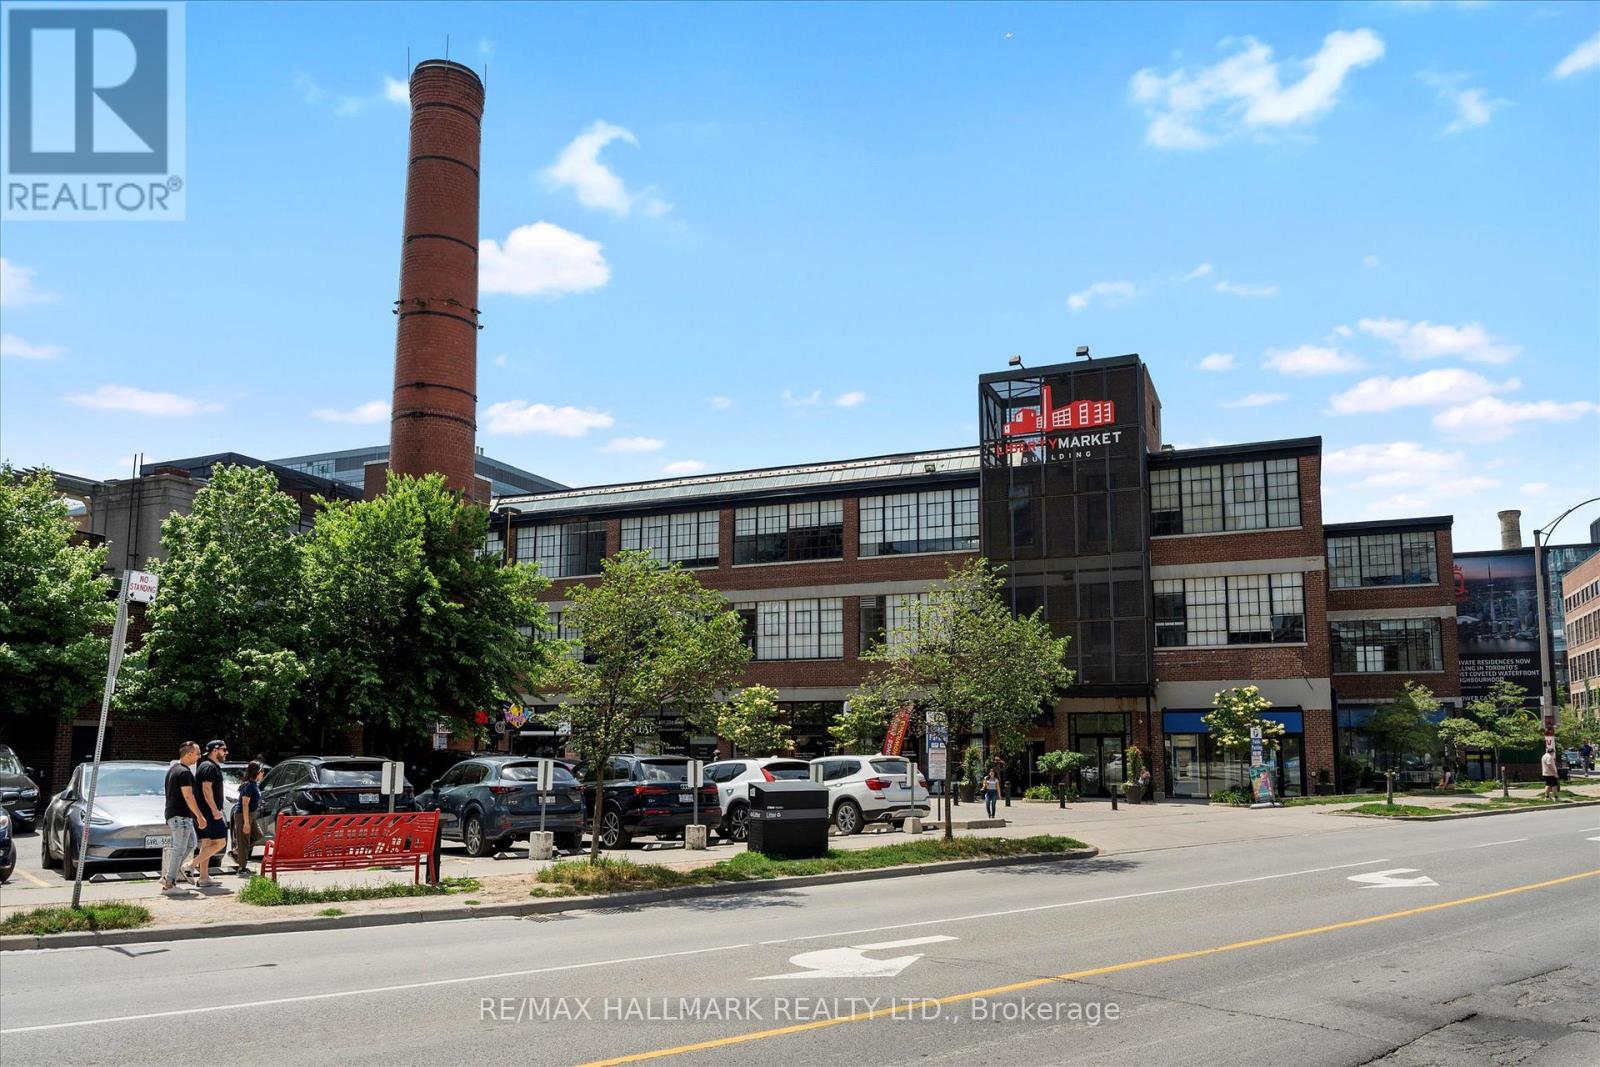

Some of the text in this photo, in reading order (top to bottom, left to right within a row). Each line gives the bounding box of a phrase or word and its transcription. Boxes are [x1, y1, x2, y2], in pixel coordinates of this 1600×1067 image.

[1022, 451, 1092, 464] BULDING
[140, 575, 149, 583] NO
[129, 582, 156, 593] STANDING
